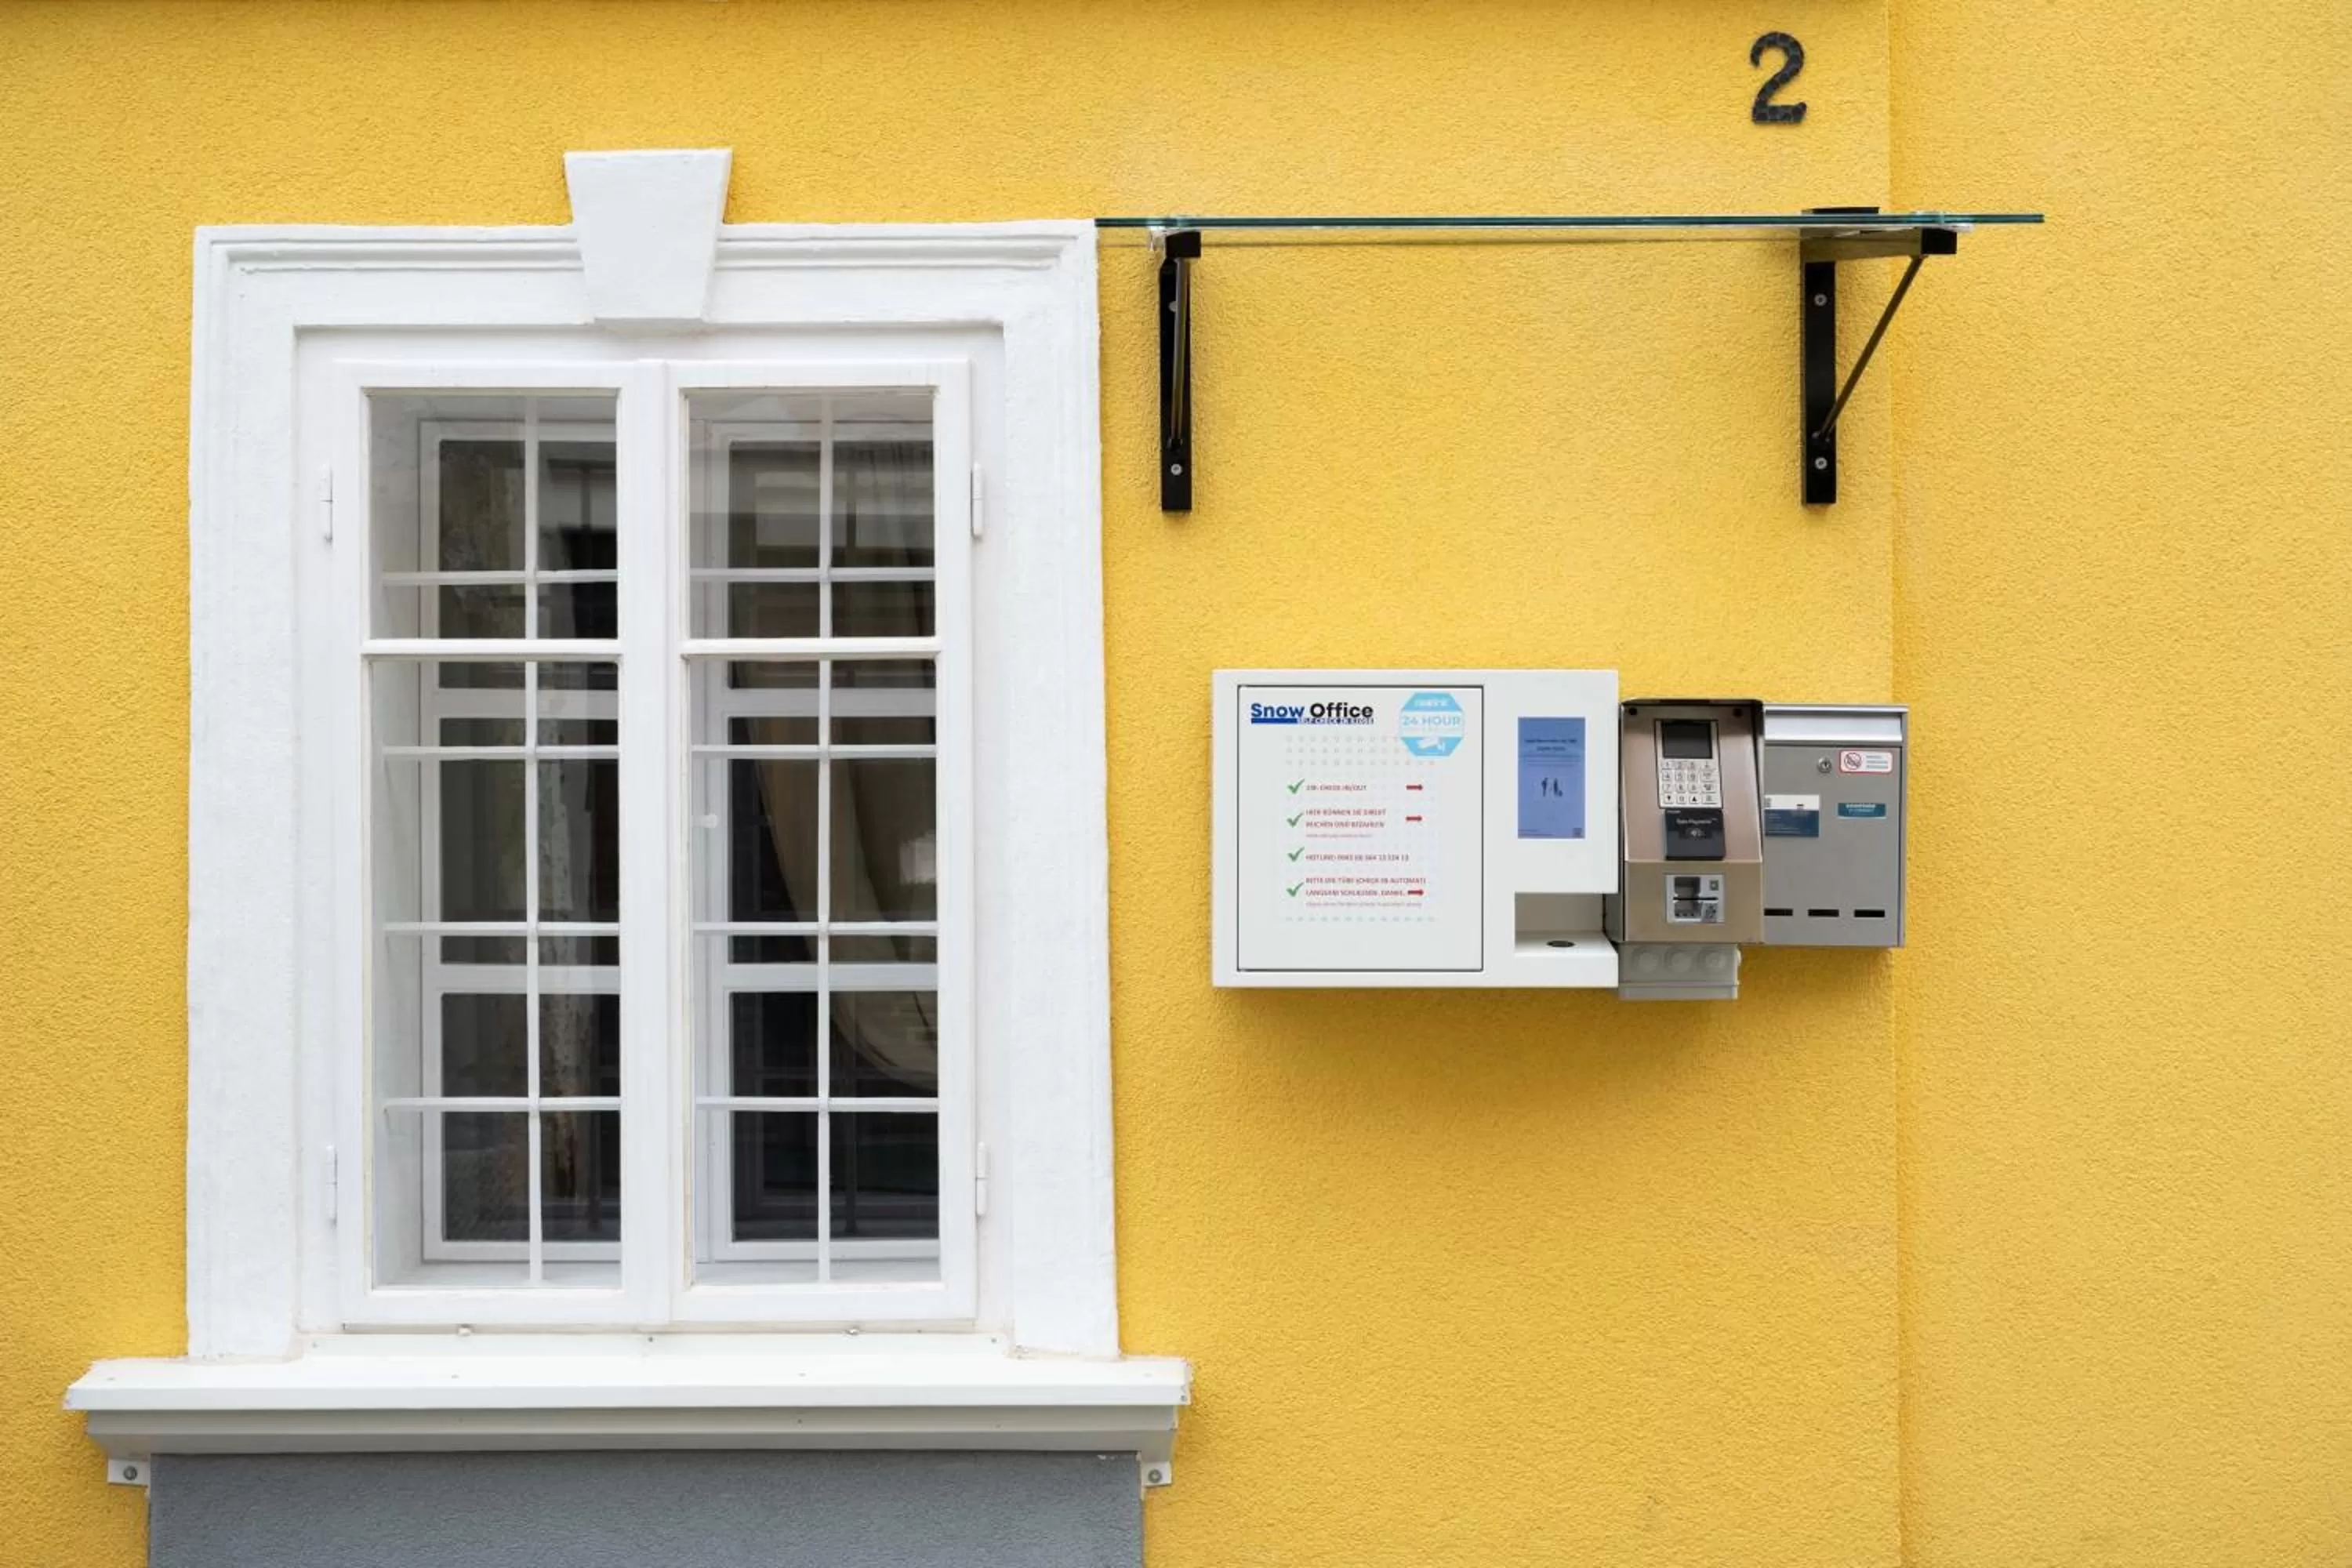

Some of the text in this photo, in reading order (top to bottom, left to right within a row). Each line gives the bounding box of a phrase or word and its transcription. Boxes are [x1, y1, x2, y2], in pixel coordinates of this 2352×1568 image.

[1750, 31, 1806, 124] 2
[1250, 702, 1374, 717] Snow Office
